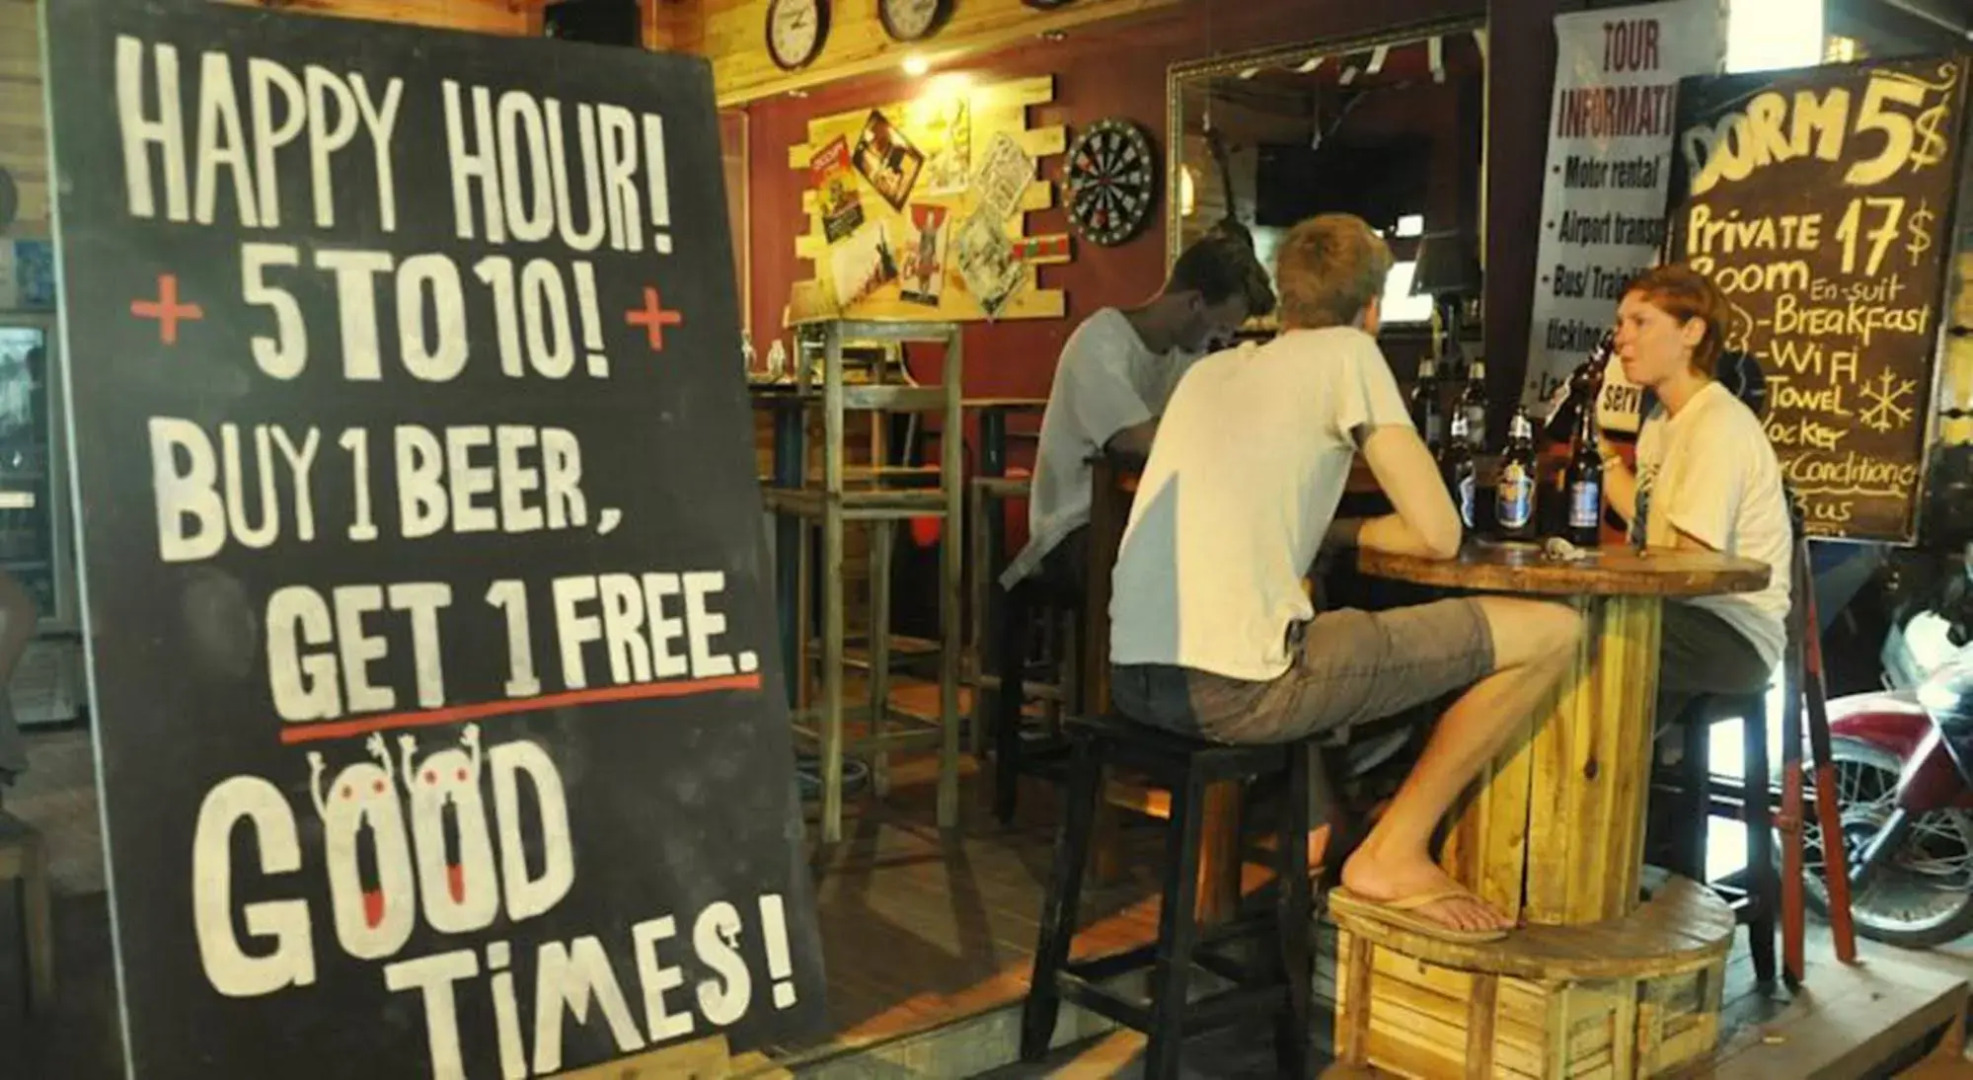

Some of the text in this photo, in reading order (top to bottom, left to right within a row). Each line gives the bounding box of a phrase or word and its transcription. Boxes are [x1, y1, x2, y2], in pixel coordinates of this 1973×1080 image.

[1603, 19, 1659, 72] TOUR
[116, 36, 672, 254] HAPPY HOUR!
[1564, 155, 1660, 188] Motor rental
[1682, 87, 1850, 196] DORM
[1559, 209, 1610, 248] Airport
[241, 243, 308, 380] 5
[315, 249, 469, 382] TO
[148, 416, 622, 562] BUY 1 BEER,
[266, 570, 759, 722] GET 1 FREE.
[192, 724, 575, 998] GOOD
[385, 893, 797, 1080] TiMES!
